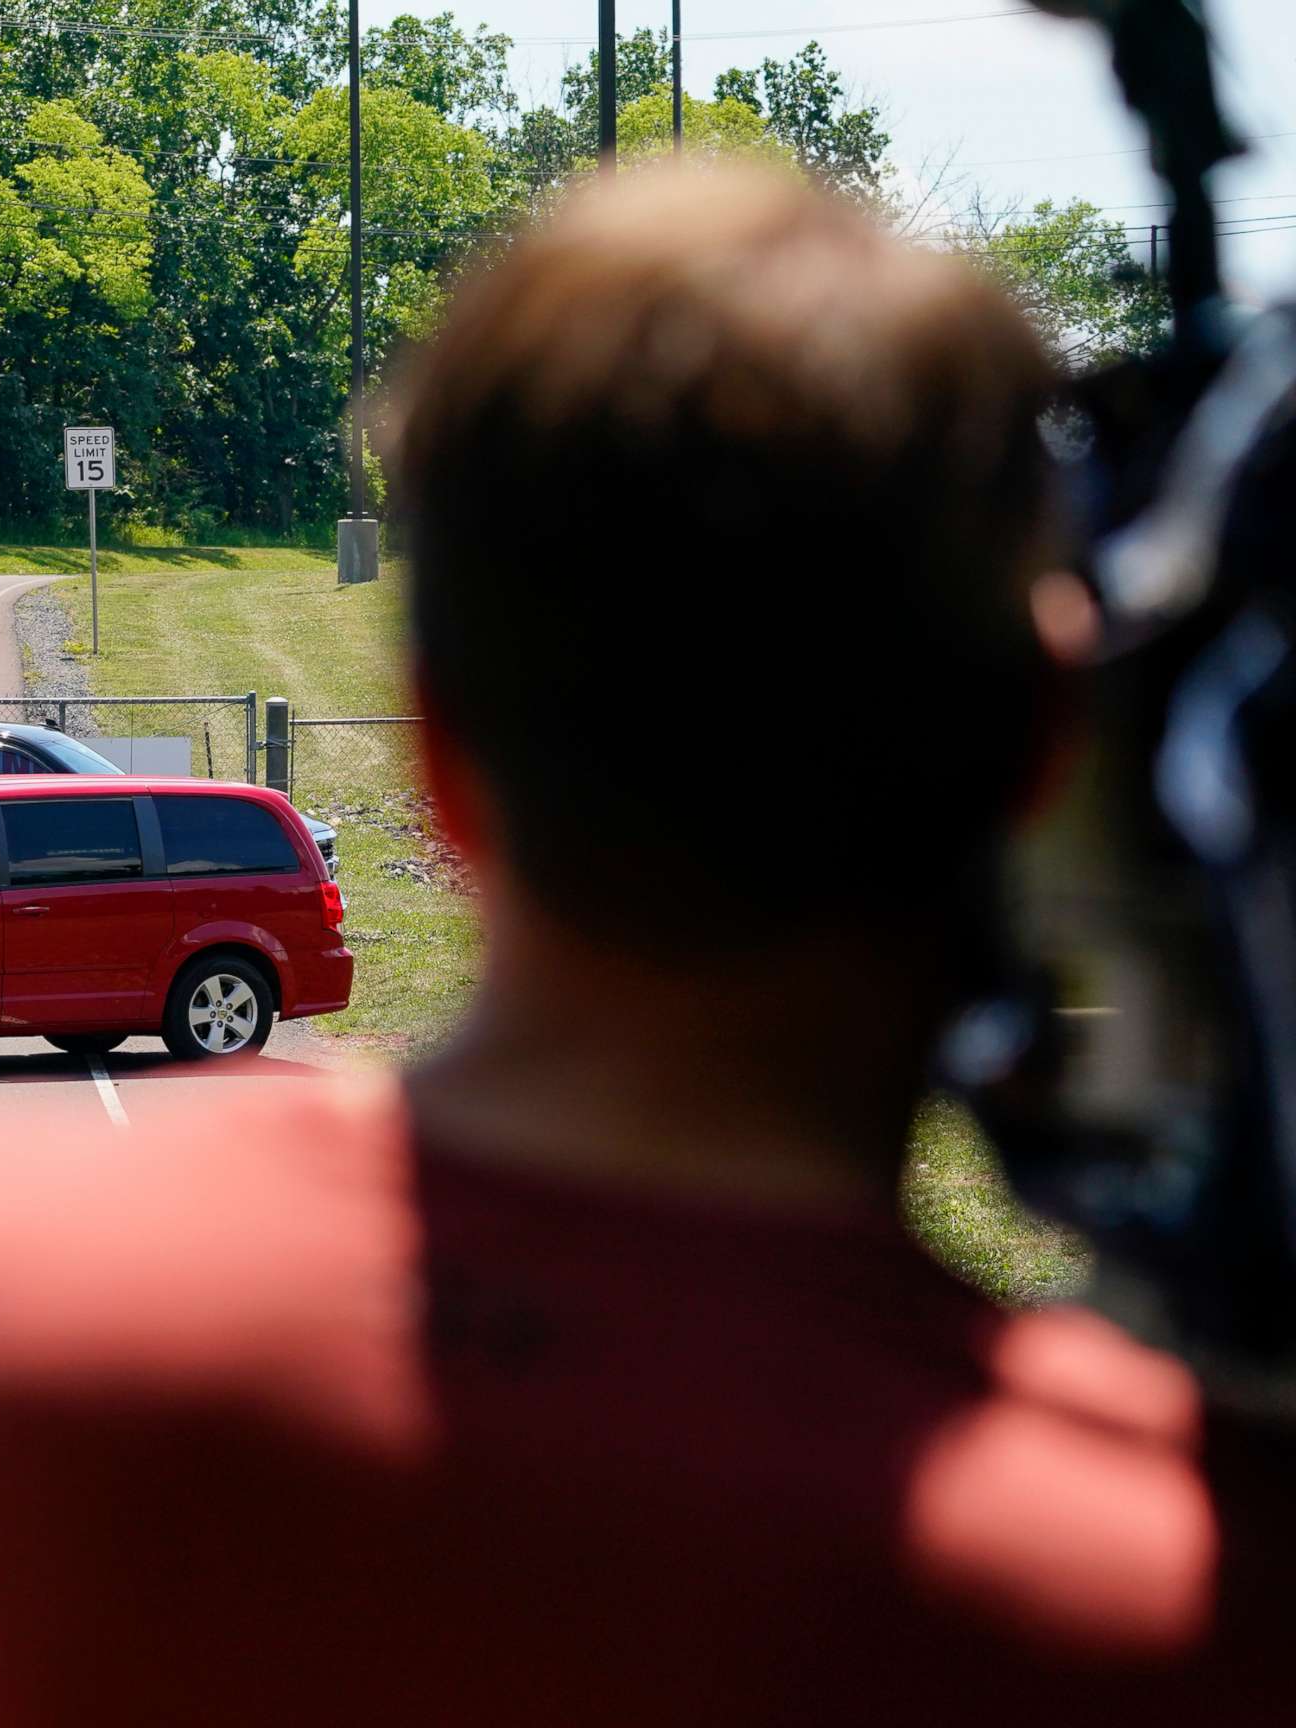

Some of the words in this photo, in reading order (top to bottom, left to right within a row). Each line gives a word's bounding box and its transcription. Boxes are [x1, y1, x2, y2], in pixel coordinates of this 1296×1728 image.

[70, 435, 110, 445] SPEED
[74, 448, 106, 458] LIMIT
[77, 460, 104, 481] 15
